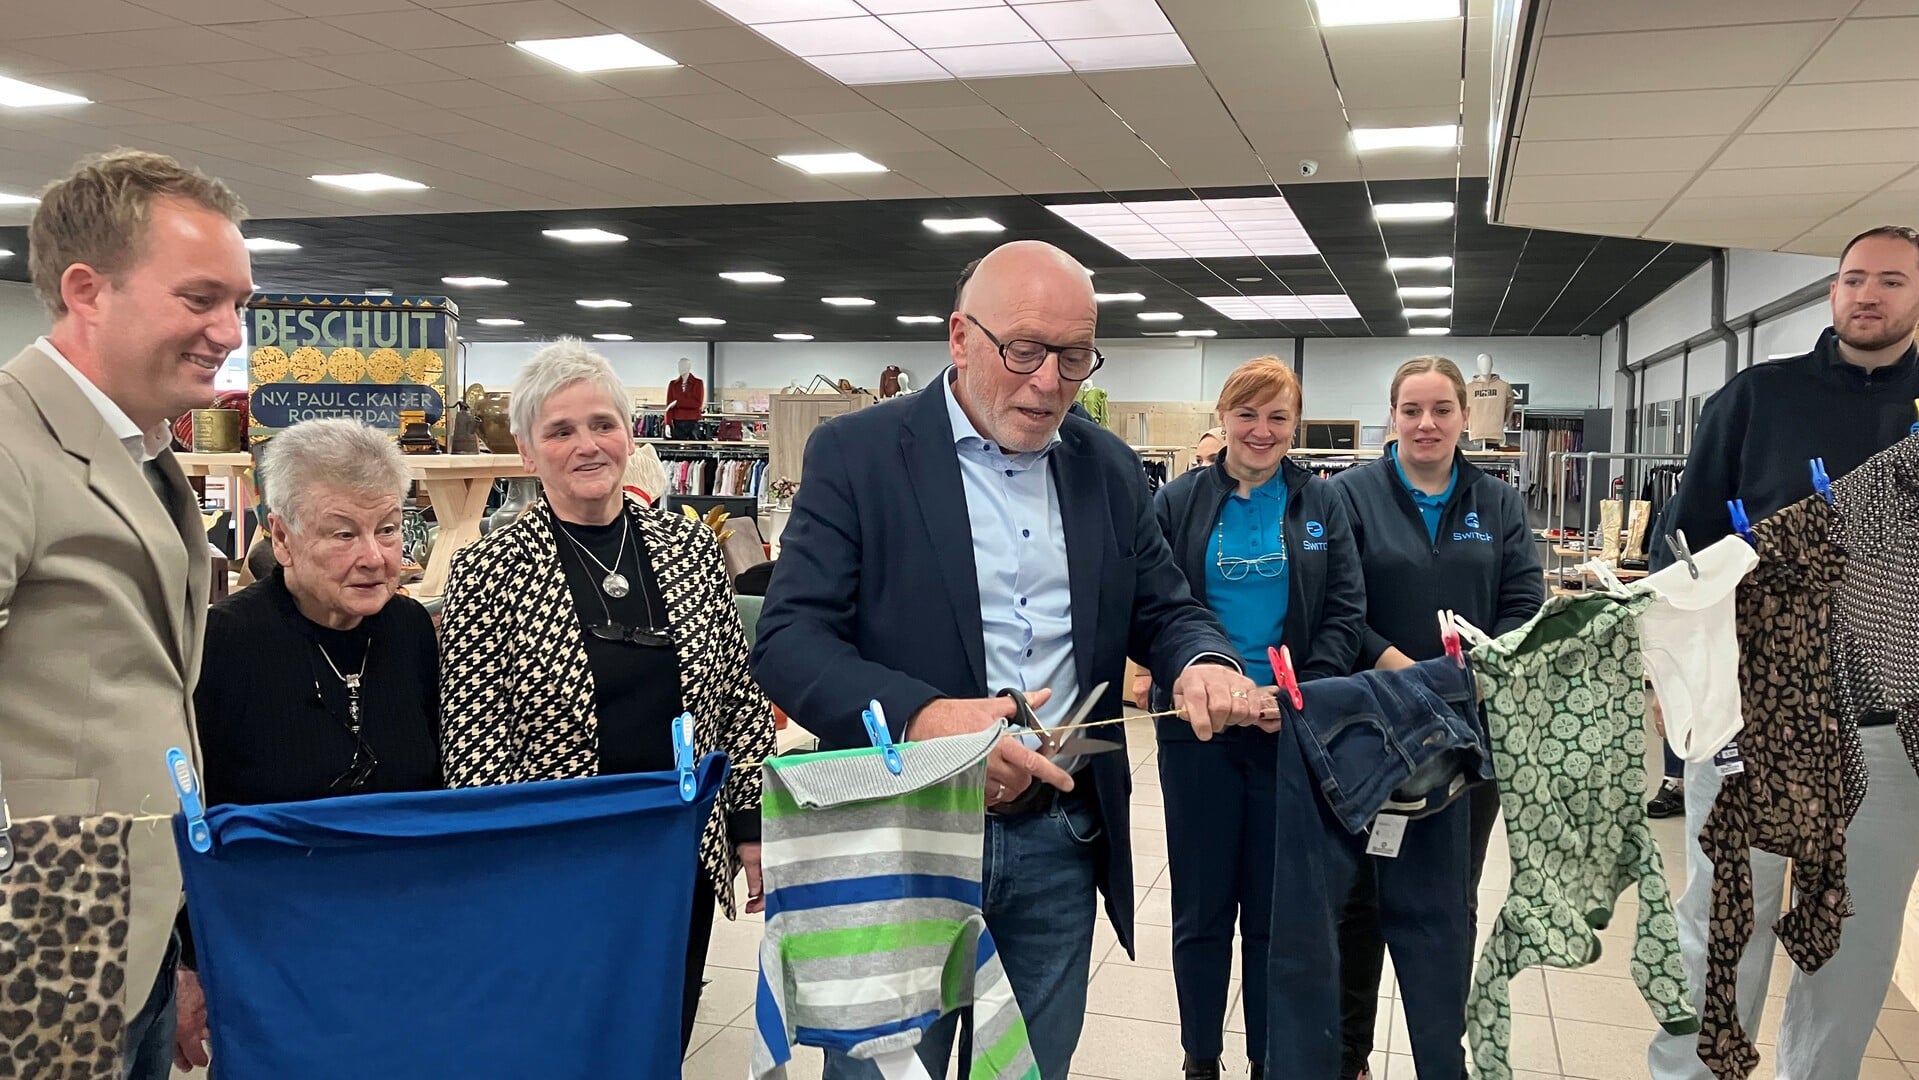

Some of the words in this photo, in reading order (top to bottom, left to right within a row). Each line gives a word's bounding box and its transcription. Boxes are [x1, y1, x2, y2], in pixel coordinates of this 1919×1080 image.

[255, 309, 435, 348] BESCHUIT
[261, 391, 290, 407] N.V.
[297, 392, 345, 406] PAUL
